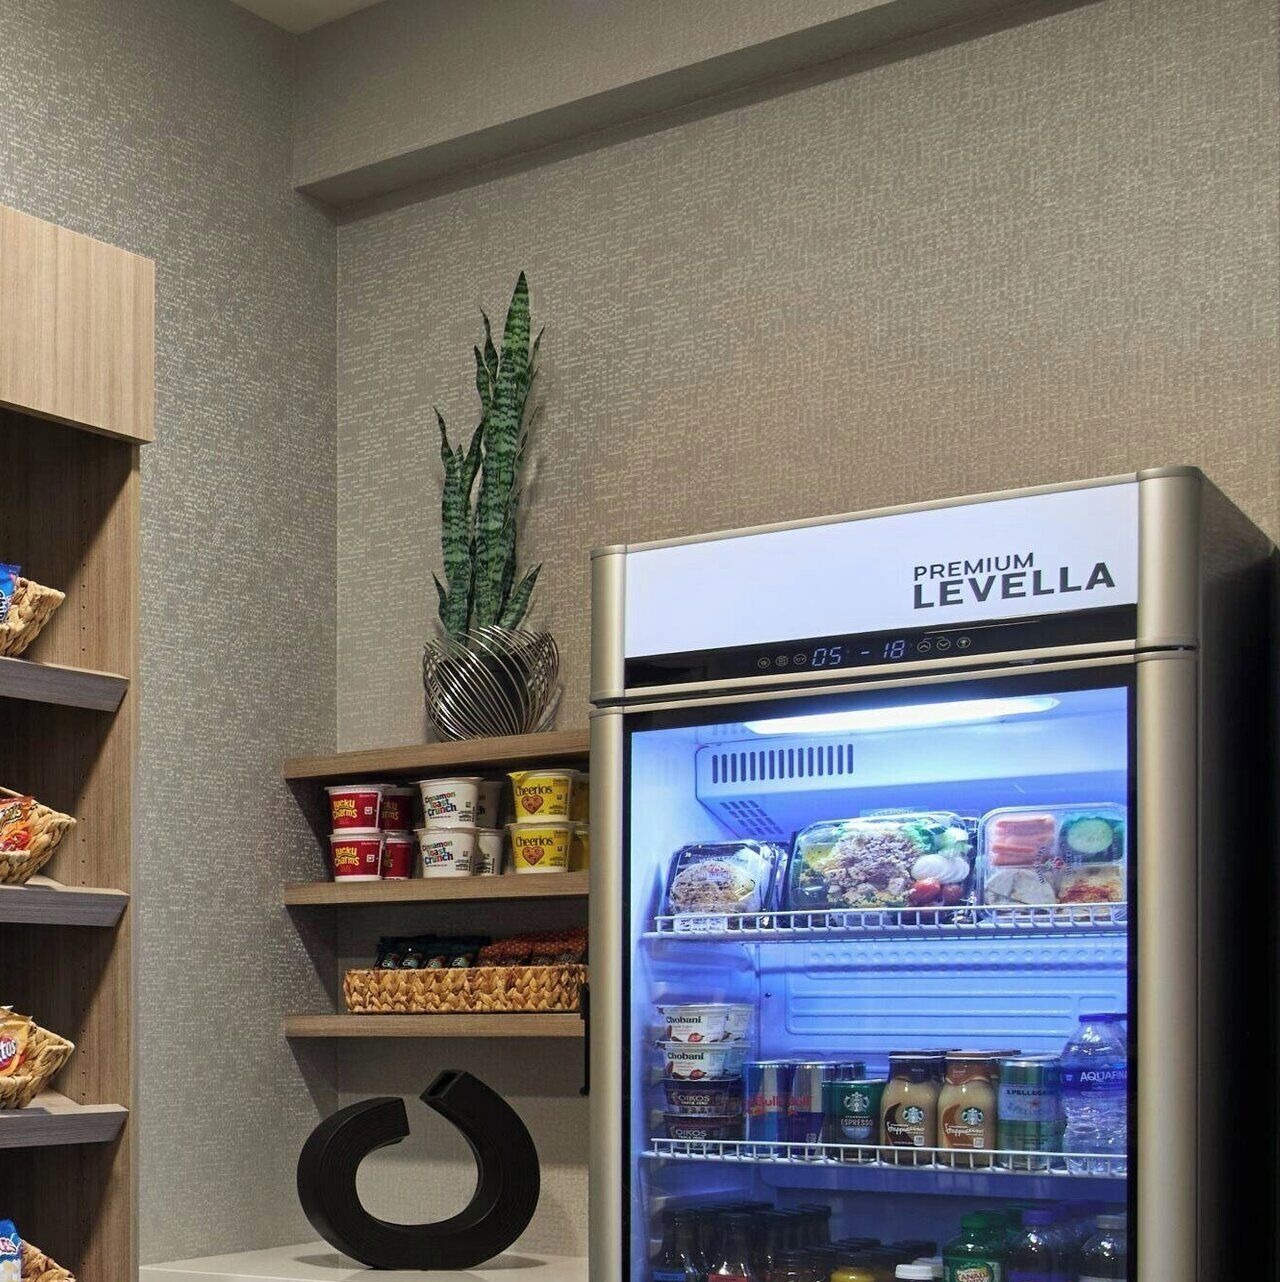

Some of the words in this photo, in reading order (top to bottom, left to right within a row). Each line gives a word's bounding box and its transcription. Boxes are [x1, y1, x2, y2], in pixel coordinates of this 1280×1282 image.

[914, 552, 1034, 581] PREMIUM
[913, 562, 1115, 609] LEVELLA
[515, 785, 553, 796] Cheerios
[516, 836, 554, 847] Cheerios
[666, 1016, 701, 1024] Chobani
[667, 1052, 704, 1060] Chobani
[841, 1118, 873, 1126] ESPRESSO
